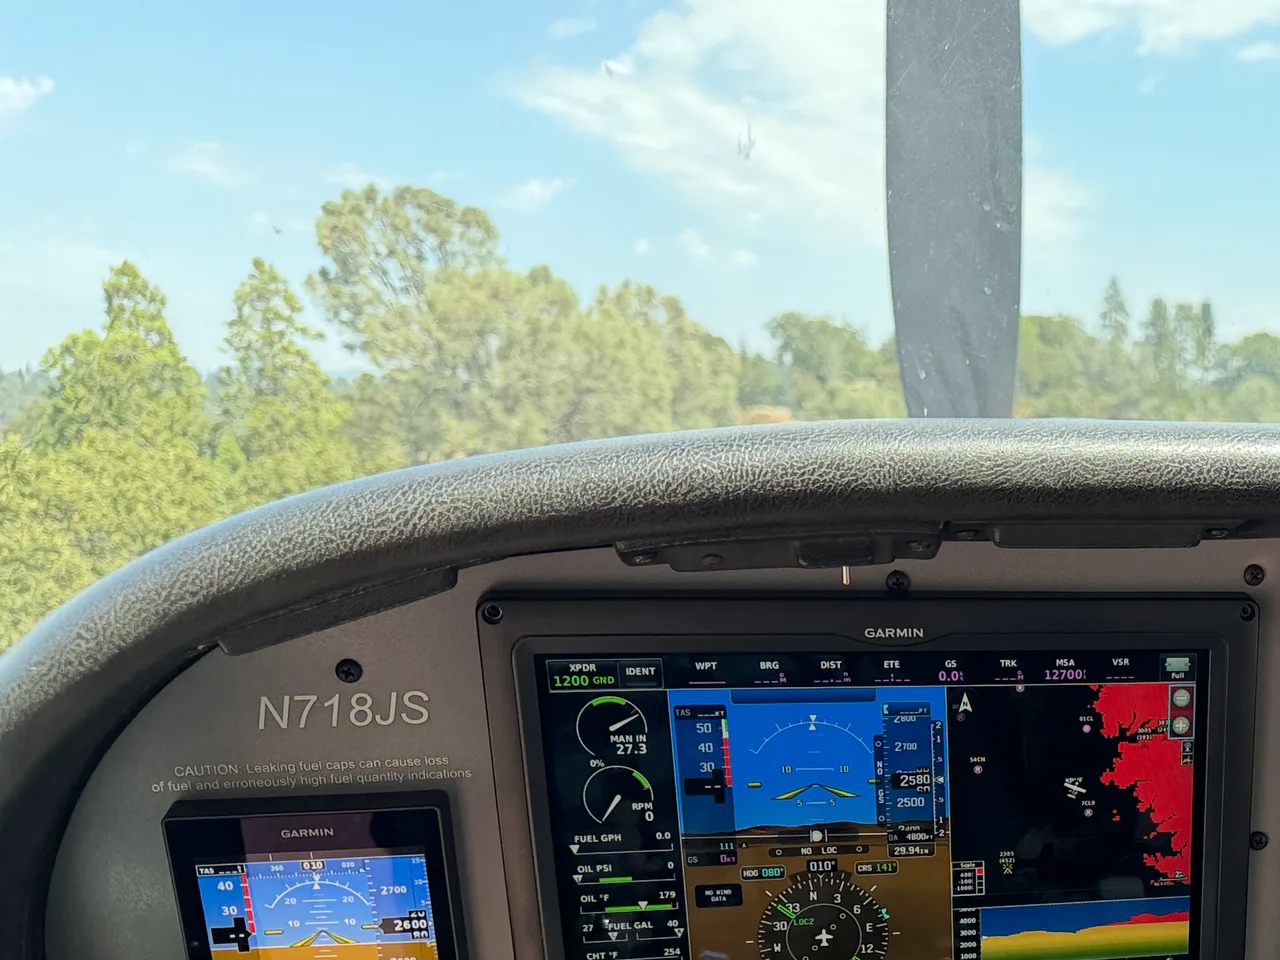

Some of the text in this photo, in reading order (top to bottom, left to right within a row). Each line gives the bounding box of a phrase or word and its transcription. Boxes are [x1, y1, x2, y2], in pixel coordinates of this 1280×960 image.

[864, 628, 924, 639] GARMIN
[569, 658, 1130, 672] XPDR WPT BRG DIST ETE GS TRK MSA VSR
[625, 667, 656, 676] IDENT
[553, 675, 615, 687] 1200 GND
[258, 690, 430, 729] N718JS
[610, 734, 647, 743] MAN IN
[616, 743, 648, 755] 27.3
[174, 756, 450, 777] CAUTION: Leaking fuel caps can cause loss
[152, 768, 472, 793] of fuel and erroneously high fuel quantity indications
[900, 774, 931, 787] 2580
[631, 801, 653, 811] RPM
[281, 827, 334, 838] GARMIN
[574, 831, 671, 843] FUEL GPH 0.0
[577, 863, 612, 873] OIL PSI
[217, 882, 234, 891] 40
[380, 886, 407, 894] 2700
[659, 890, 676, 899] 179
[222, 907, 237, 916] 30
[394, 921, 427, 932] 2600
[664, 947, 681, 957] 254
